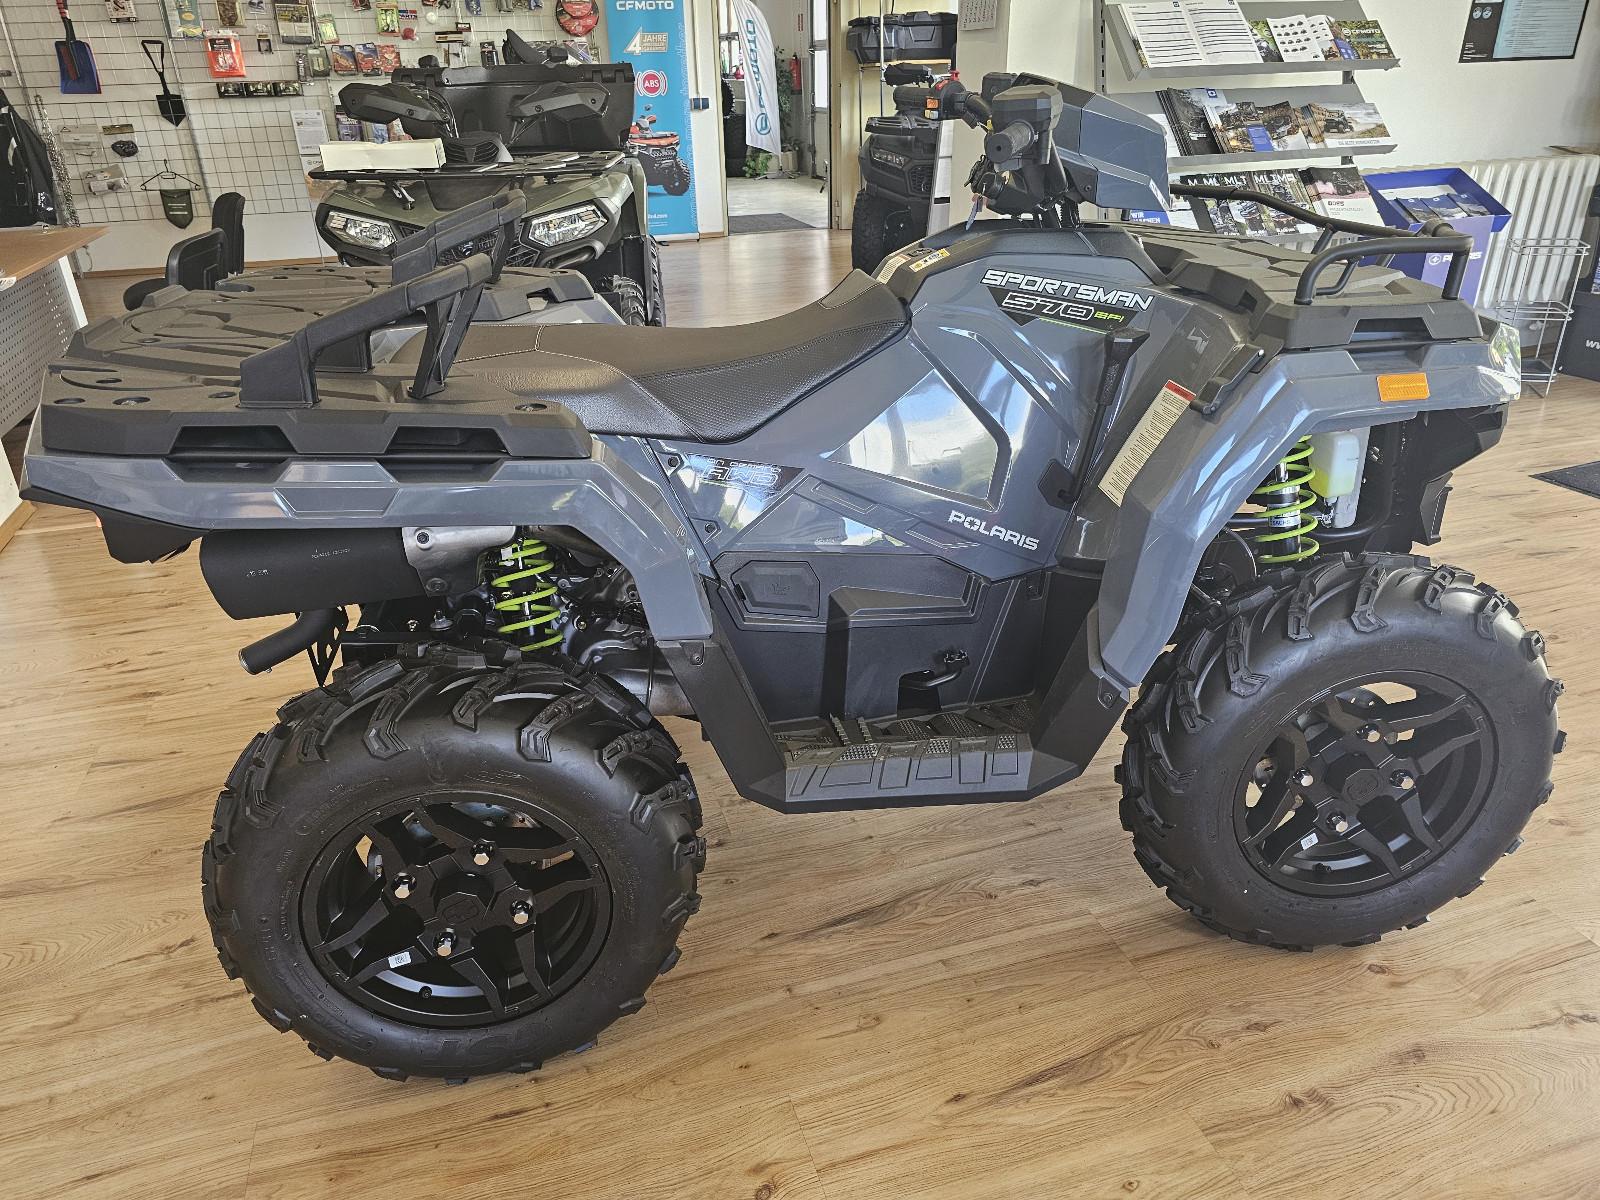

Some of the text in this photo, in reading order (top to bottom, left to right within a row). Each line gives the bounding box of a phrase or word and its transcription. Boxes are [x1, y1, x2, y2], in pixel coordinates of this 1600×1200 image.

[616, 1, 675, 11] CFMOTO
[626, 30, 667, 55] 4 JAHRE
[643, 79, 660, 88] ABS
[981, 269, 1155, 312] SPORTSMAN
[1001, 291, 1095, 321] 570
[701, 464, 779, 488] AWD
[947, 509, 1040, 551] POLARIS
